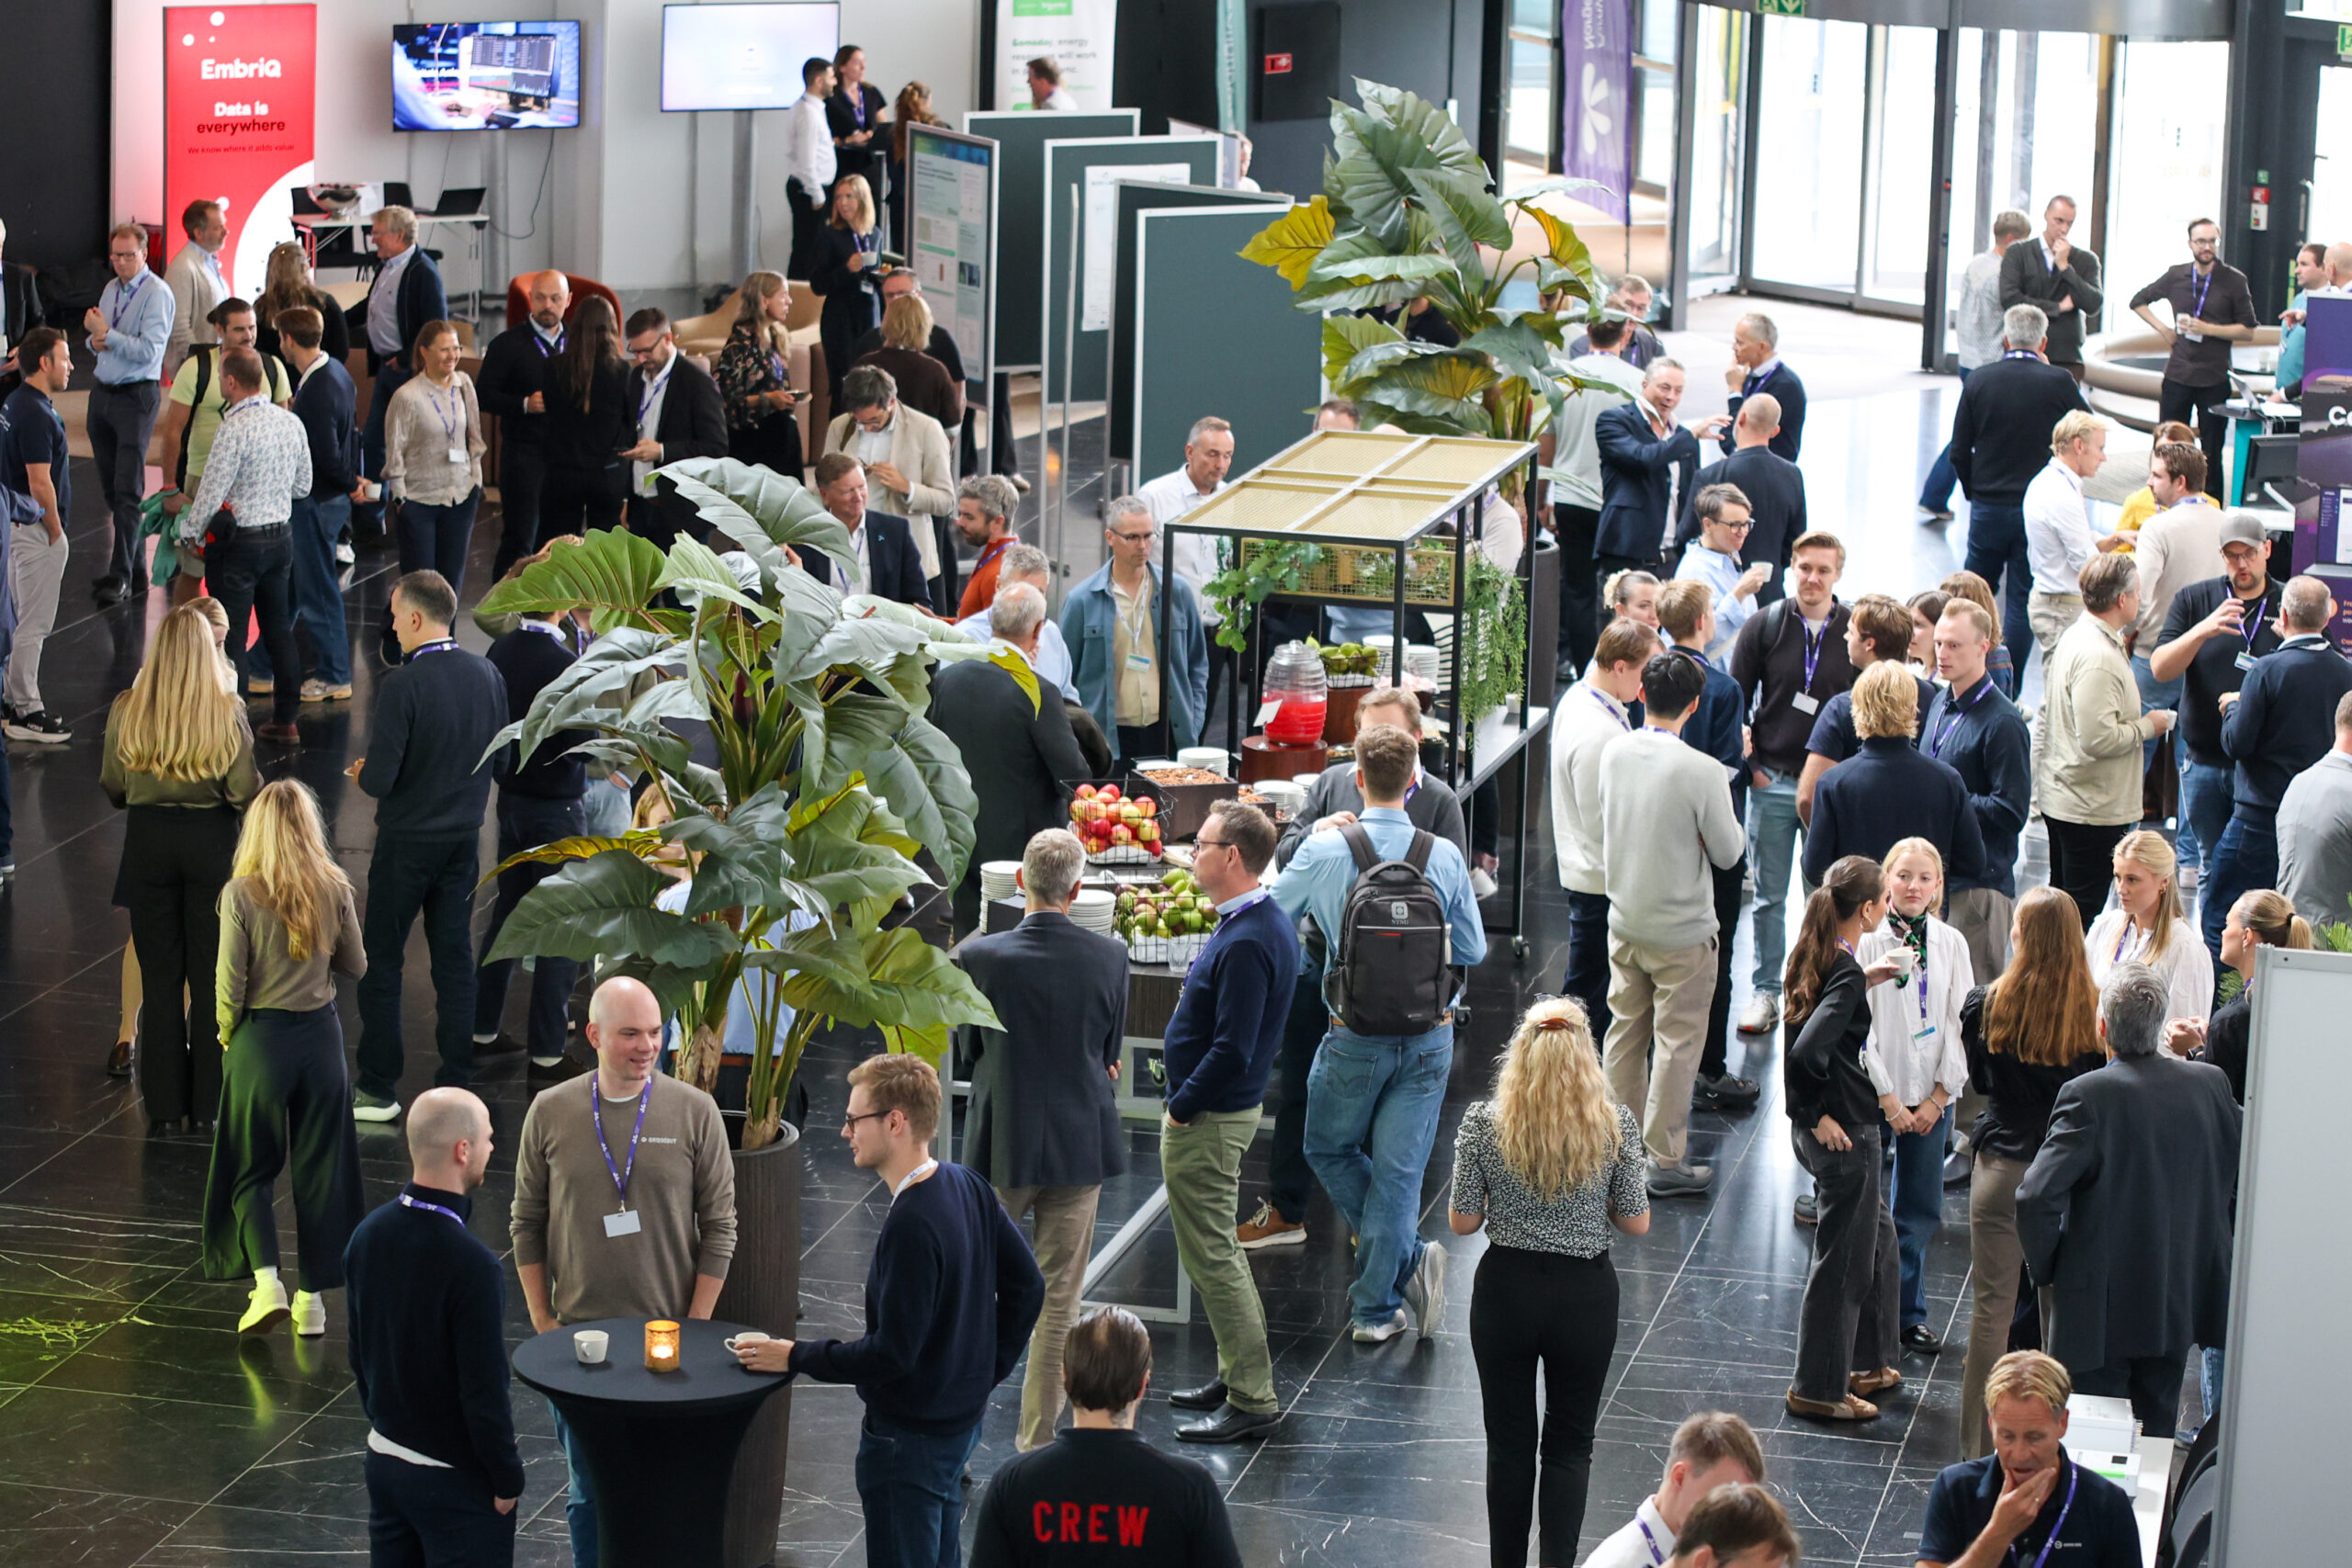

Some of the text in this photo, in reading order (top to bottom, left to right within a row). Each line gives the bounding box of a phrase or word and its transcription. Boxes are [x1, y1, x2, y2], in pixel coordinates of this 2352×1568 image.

[200, 57, 282, 80] EmbriQ
[214, 100, 269, 117] Data is
[197, 118, 286, 136] everywhere
[223, 144, 246, 153] where
[1032, 1500, 1150, 1548] CREW
